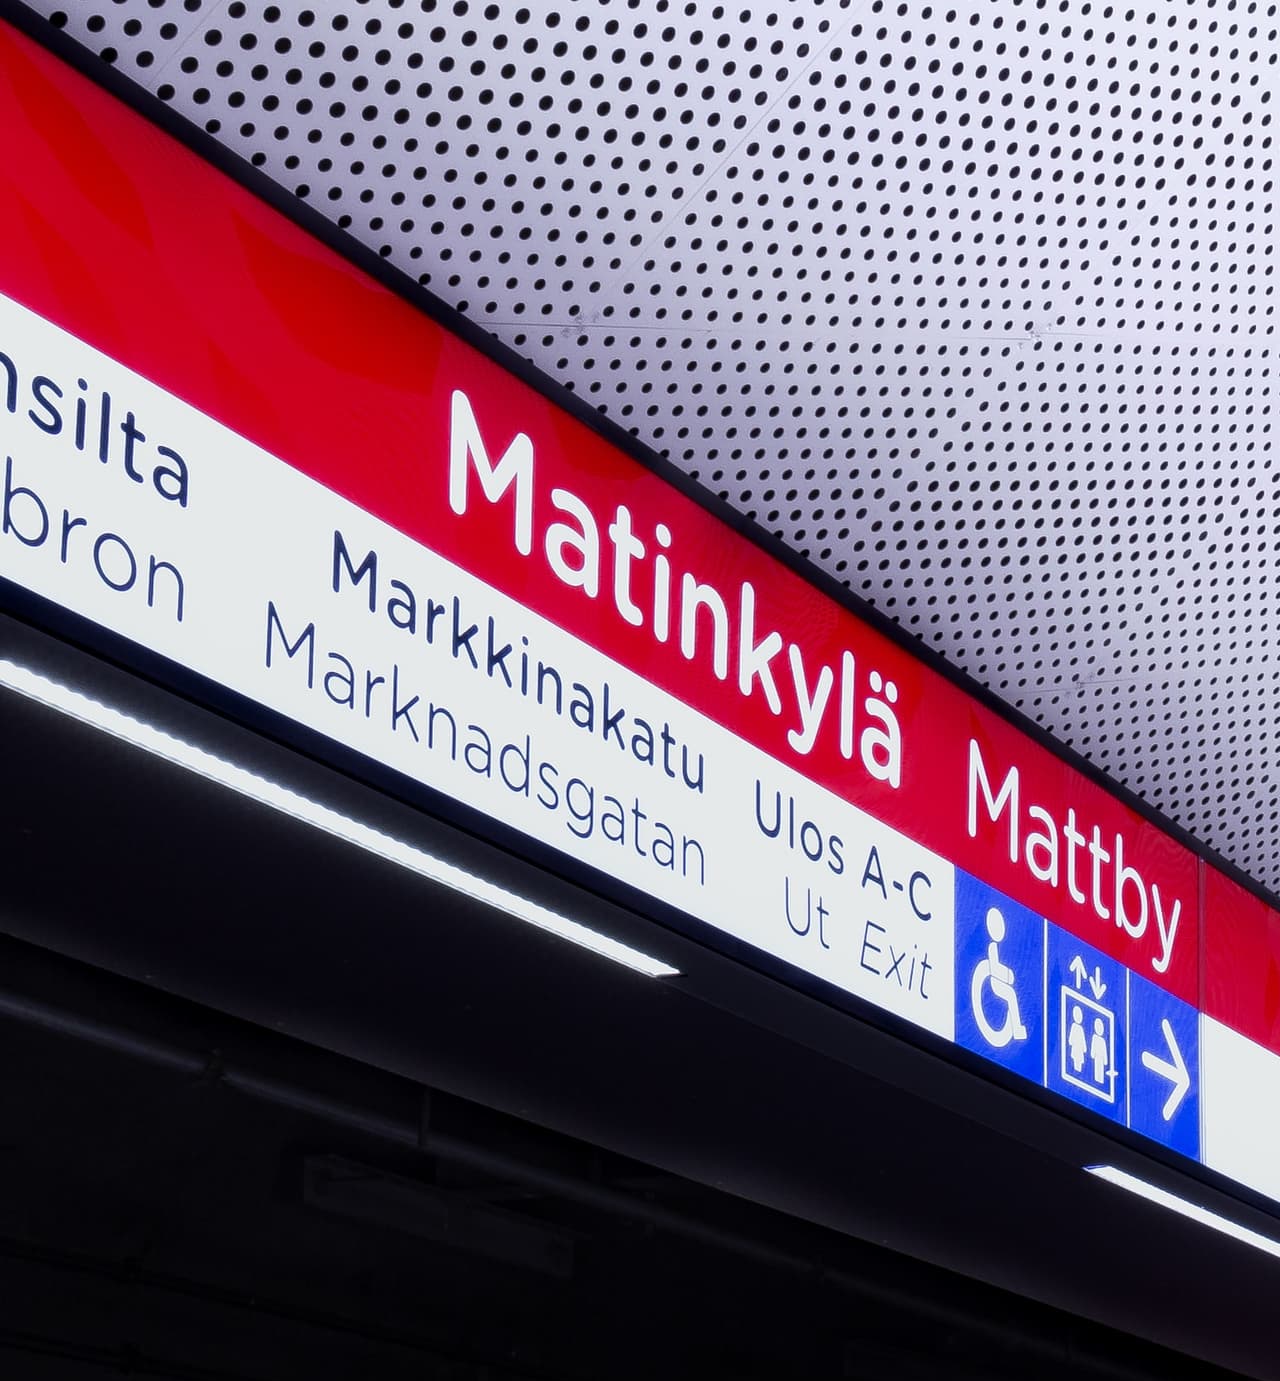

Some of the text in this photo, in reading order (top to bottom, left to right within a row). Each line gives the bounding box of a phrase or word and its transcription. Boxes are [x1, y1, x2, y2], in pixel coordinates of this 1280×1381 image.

[265, 600, 706, 886] Marknadsgatan
[784, 875, 831, 951] Ut
[860, 920, 933, 1000] Exit
[332, 530, 705, 795] Markkinakatu
[755, 778, 845, 876] Ulos
[861, 845, 933, 922] A-C
[449, 388, 1182, 973] Matinkylä Mattby
